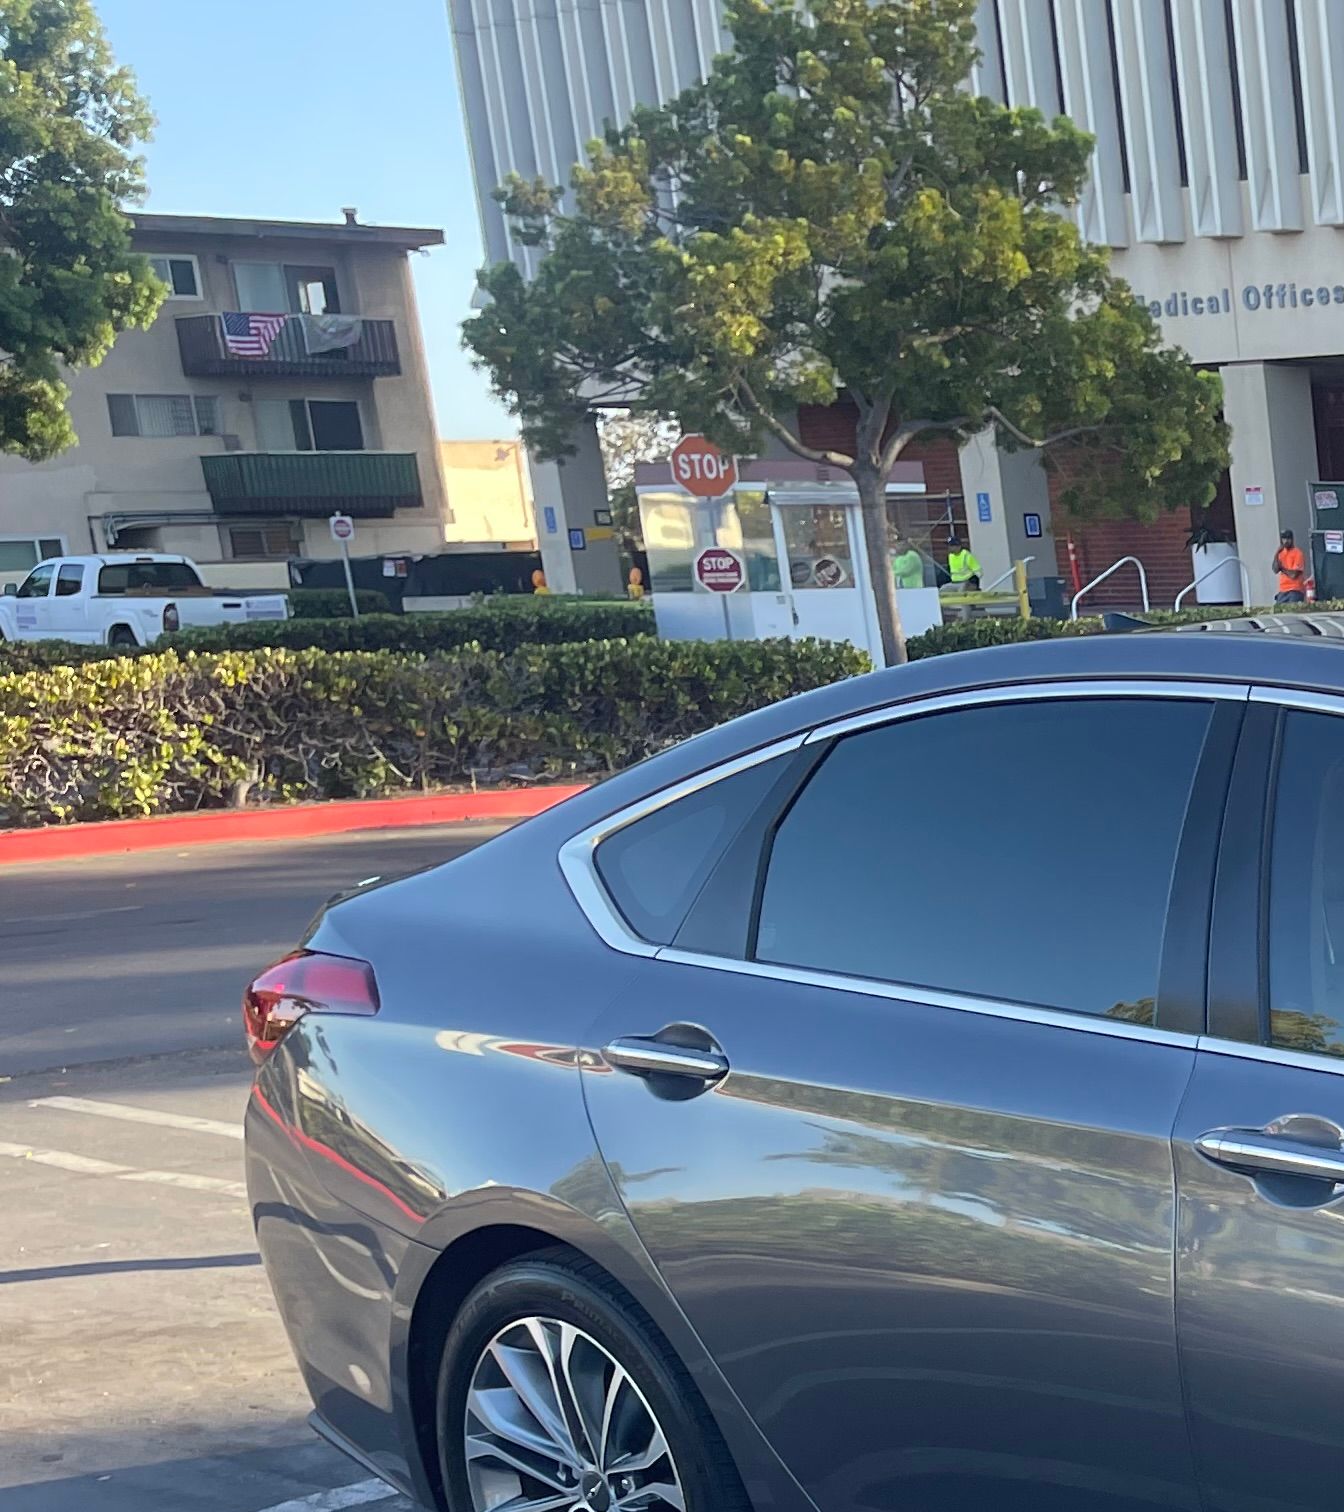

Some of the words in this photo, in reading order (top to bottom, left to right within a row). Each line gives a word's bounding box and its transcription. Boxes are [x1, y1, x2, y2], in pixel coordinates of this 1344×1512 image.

[1135, 288, 1230, 318] edical
[678, 453, 729, 480] STOP
[702, 556, 734, 571] STOP
